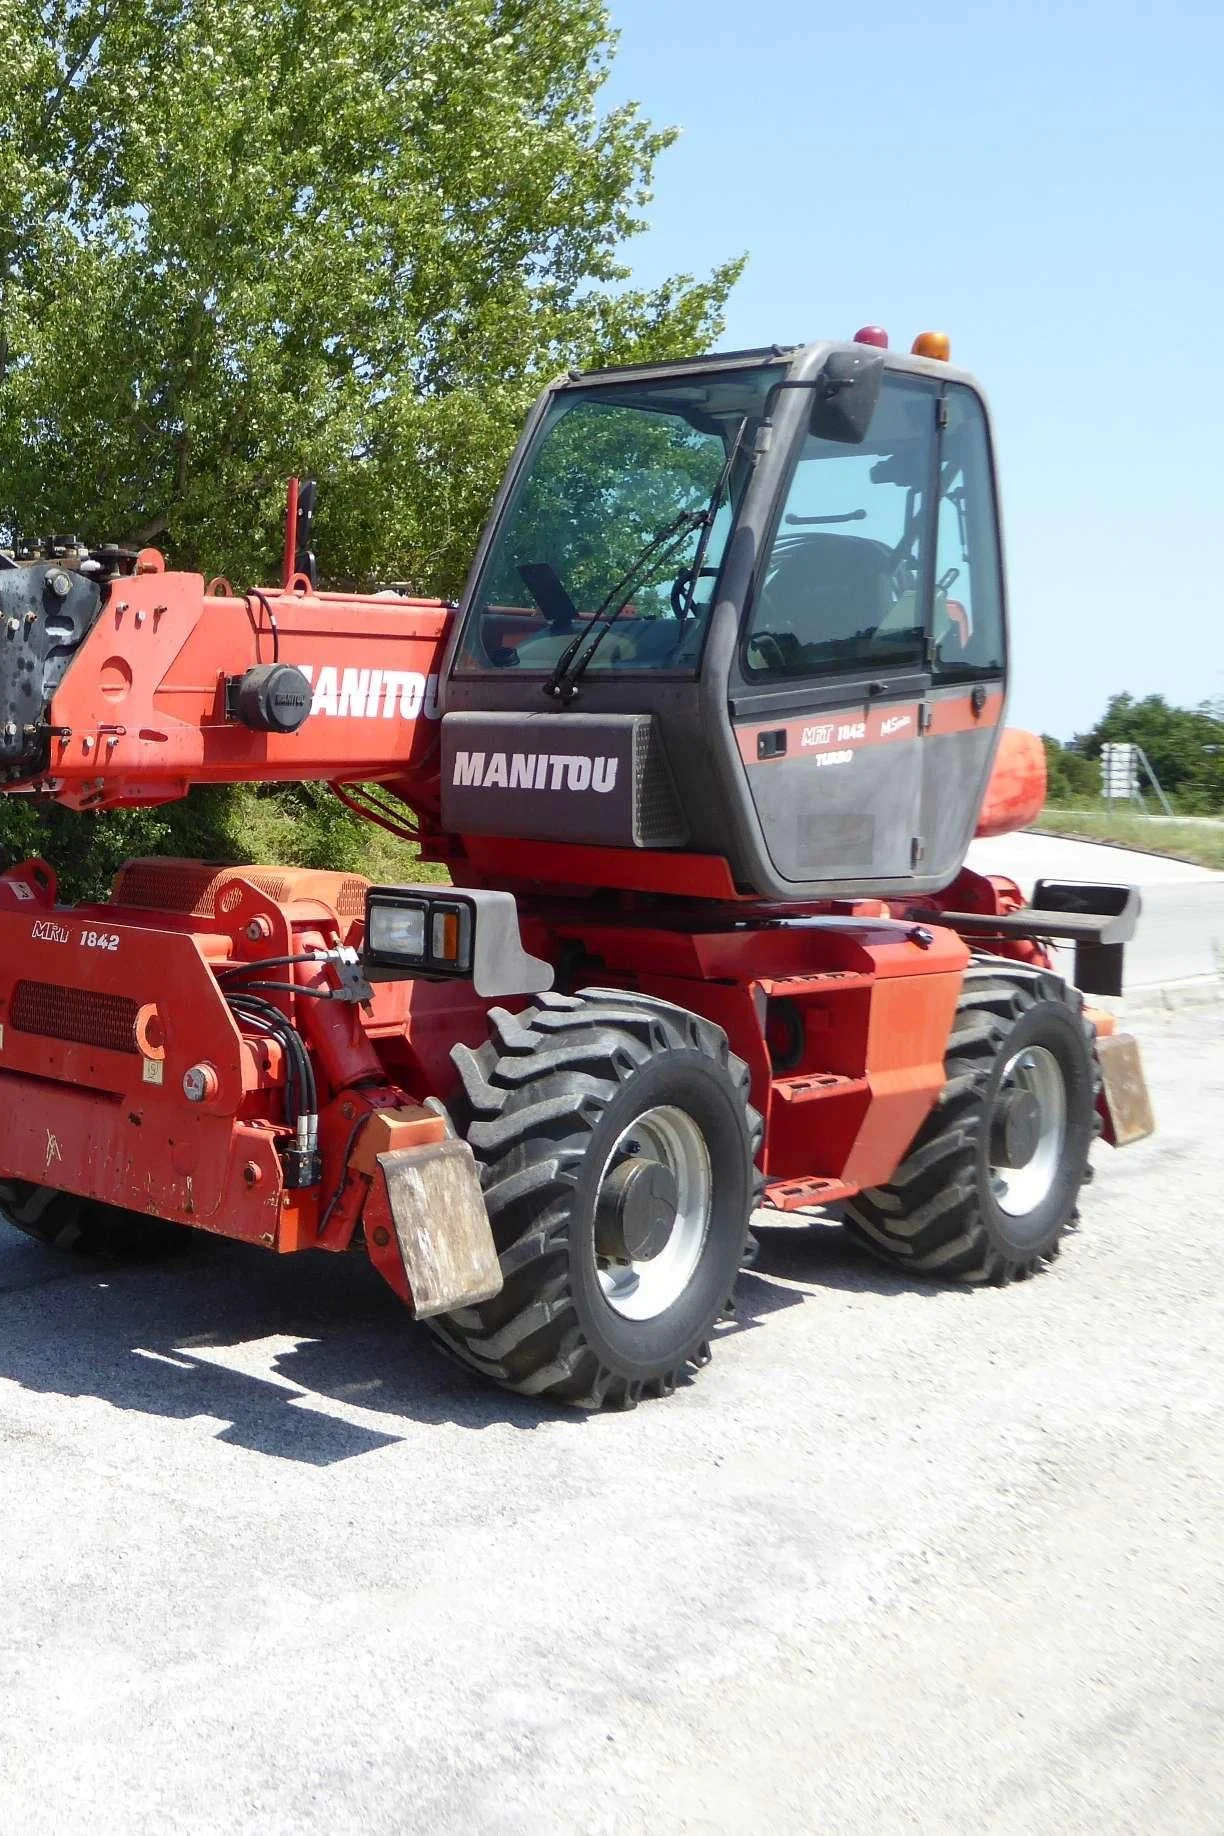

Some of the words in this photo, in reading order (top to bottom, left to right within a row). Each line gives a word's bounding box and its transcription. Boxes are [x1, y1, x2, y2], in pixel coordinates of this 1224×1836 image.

[298, 665, 443, 720] ANITOU
[452, 751, 619, 793] MANITOU
[79, 930, 120, 950] 1842
